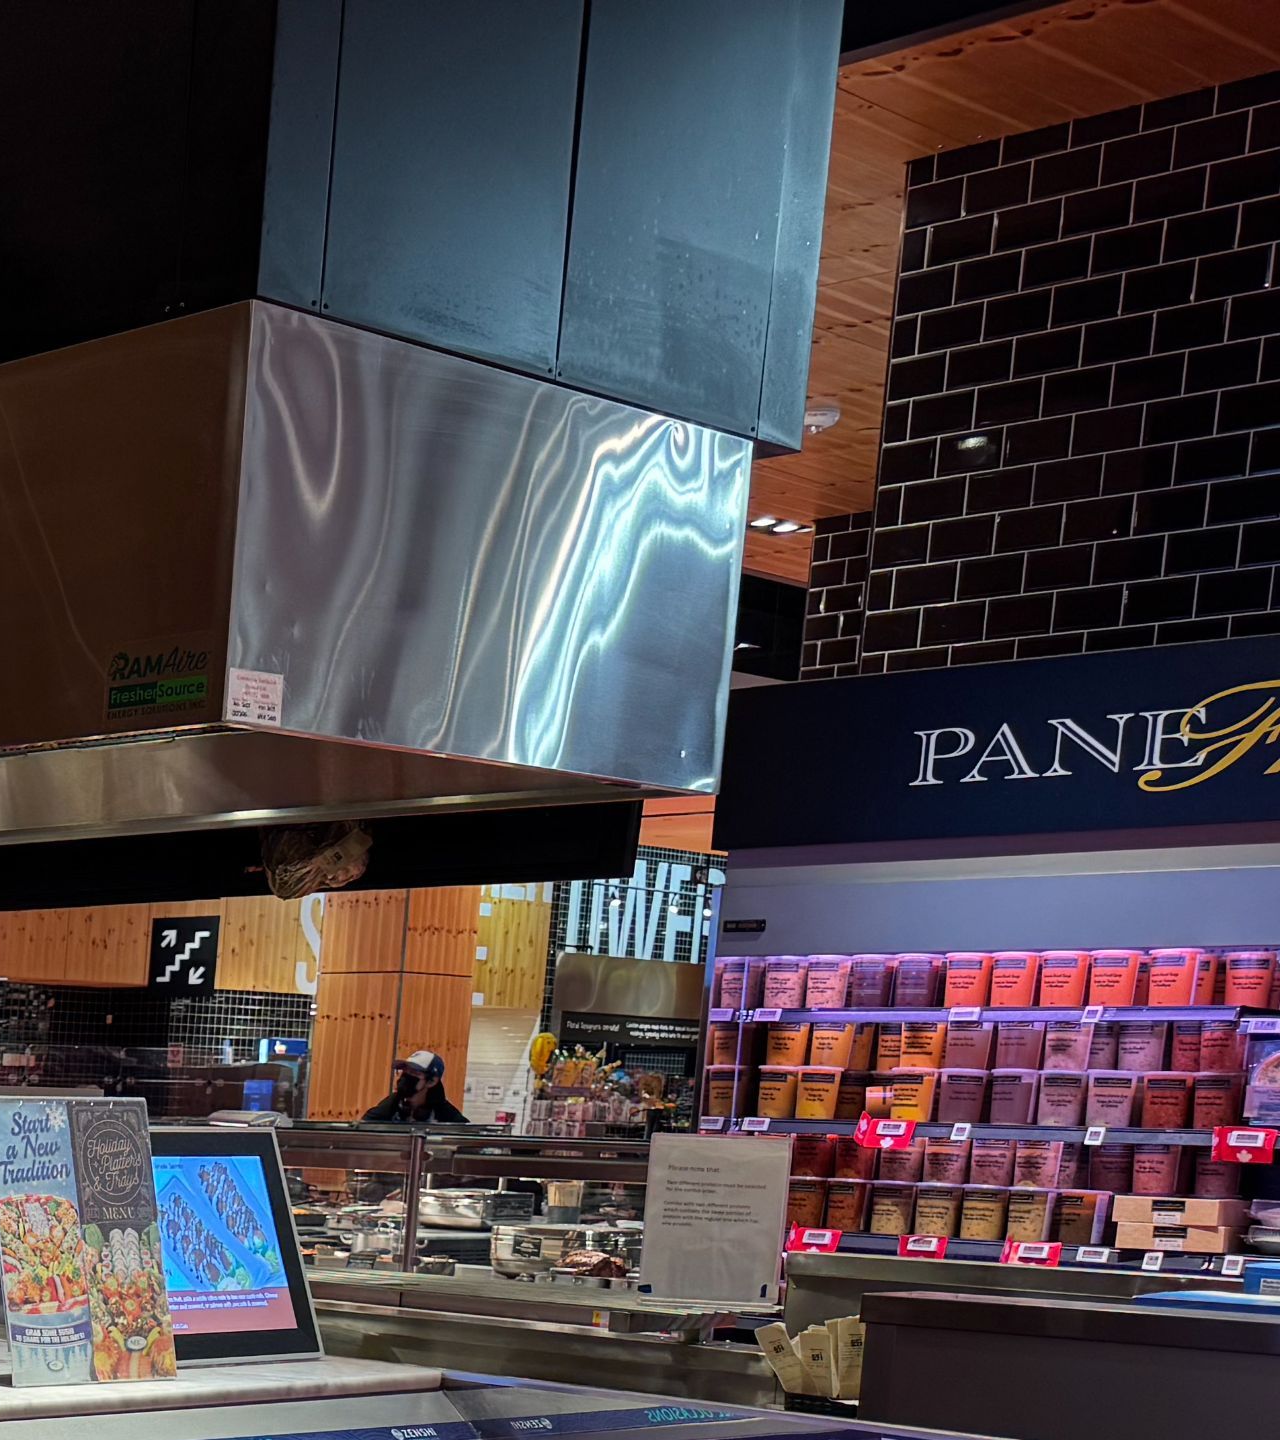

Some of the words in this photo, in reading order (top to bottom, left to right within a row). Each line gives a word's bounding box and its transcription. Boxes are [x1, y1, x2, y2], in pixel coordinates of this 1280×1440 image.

[110, 680, 205, 705] FresherSource
[909, 707, 1208, 786] PANE
[11, 1111, 51, 1136] Start
[6, 1145, 18, 1160] a
[21, 1134, 60, 1159] New
[87, 1138, 132, 1157] Holiday
[99, 1154, 142, 1174] Platters
[94, 1178, 102, 1191] &
[106, 1171, 140, 1192] Trays
[102, 1206, 135, 1220] MENU
